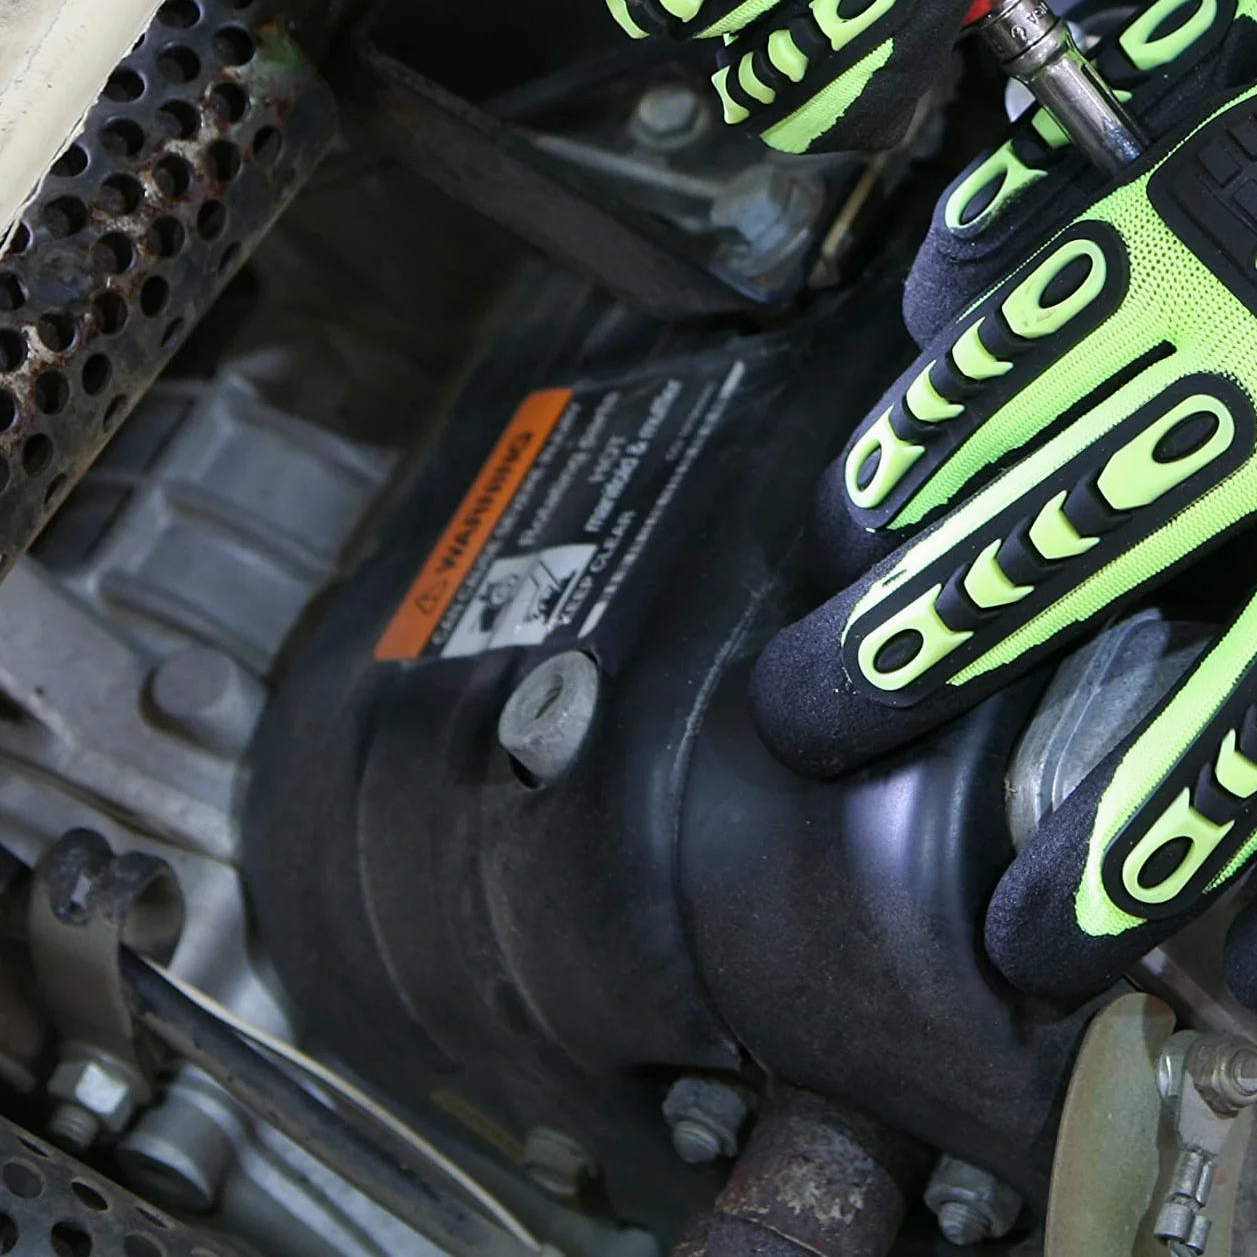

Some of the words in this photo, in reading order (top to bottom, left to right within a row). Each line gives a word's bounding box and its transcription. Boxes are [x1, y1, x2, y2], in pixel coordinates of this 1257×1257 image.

[435, 432, 535, 572] WARNING
[517, 451, 589, 546] Rotating
[588, 435, 627, 482] HOT
[556, 575, 597, 623] KEEP
[589, 510, 636, 572] CLEAR
